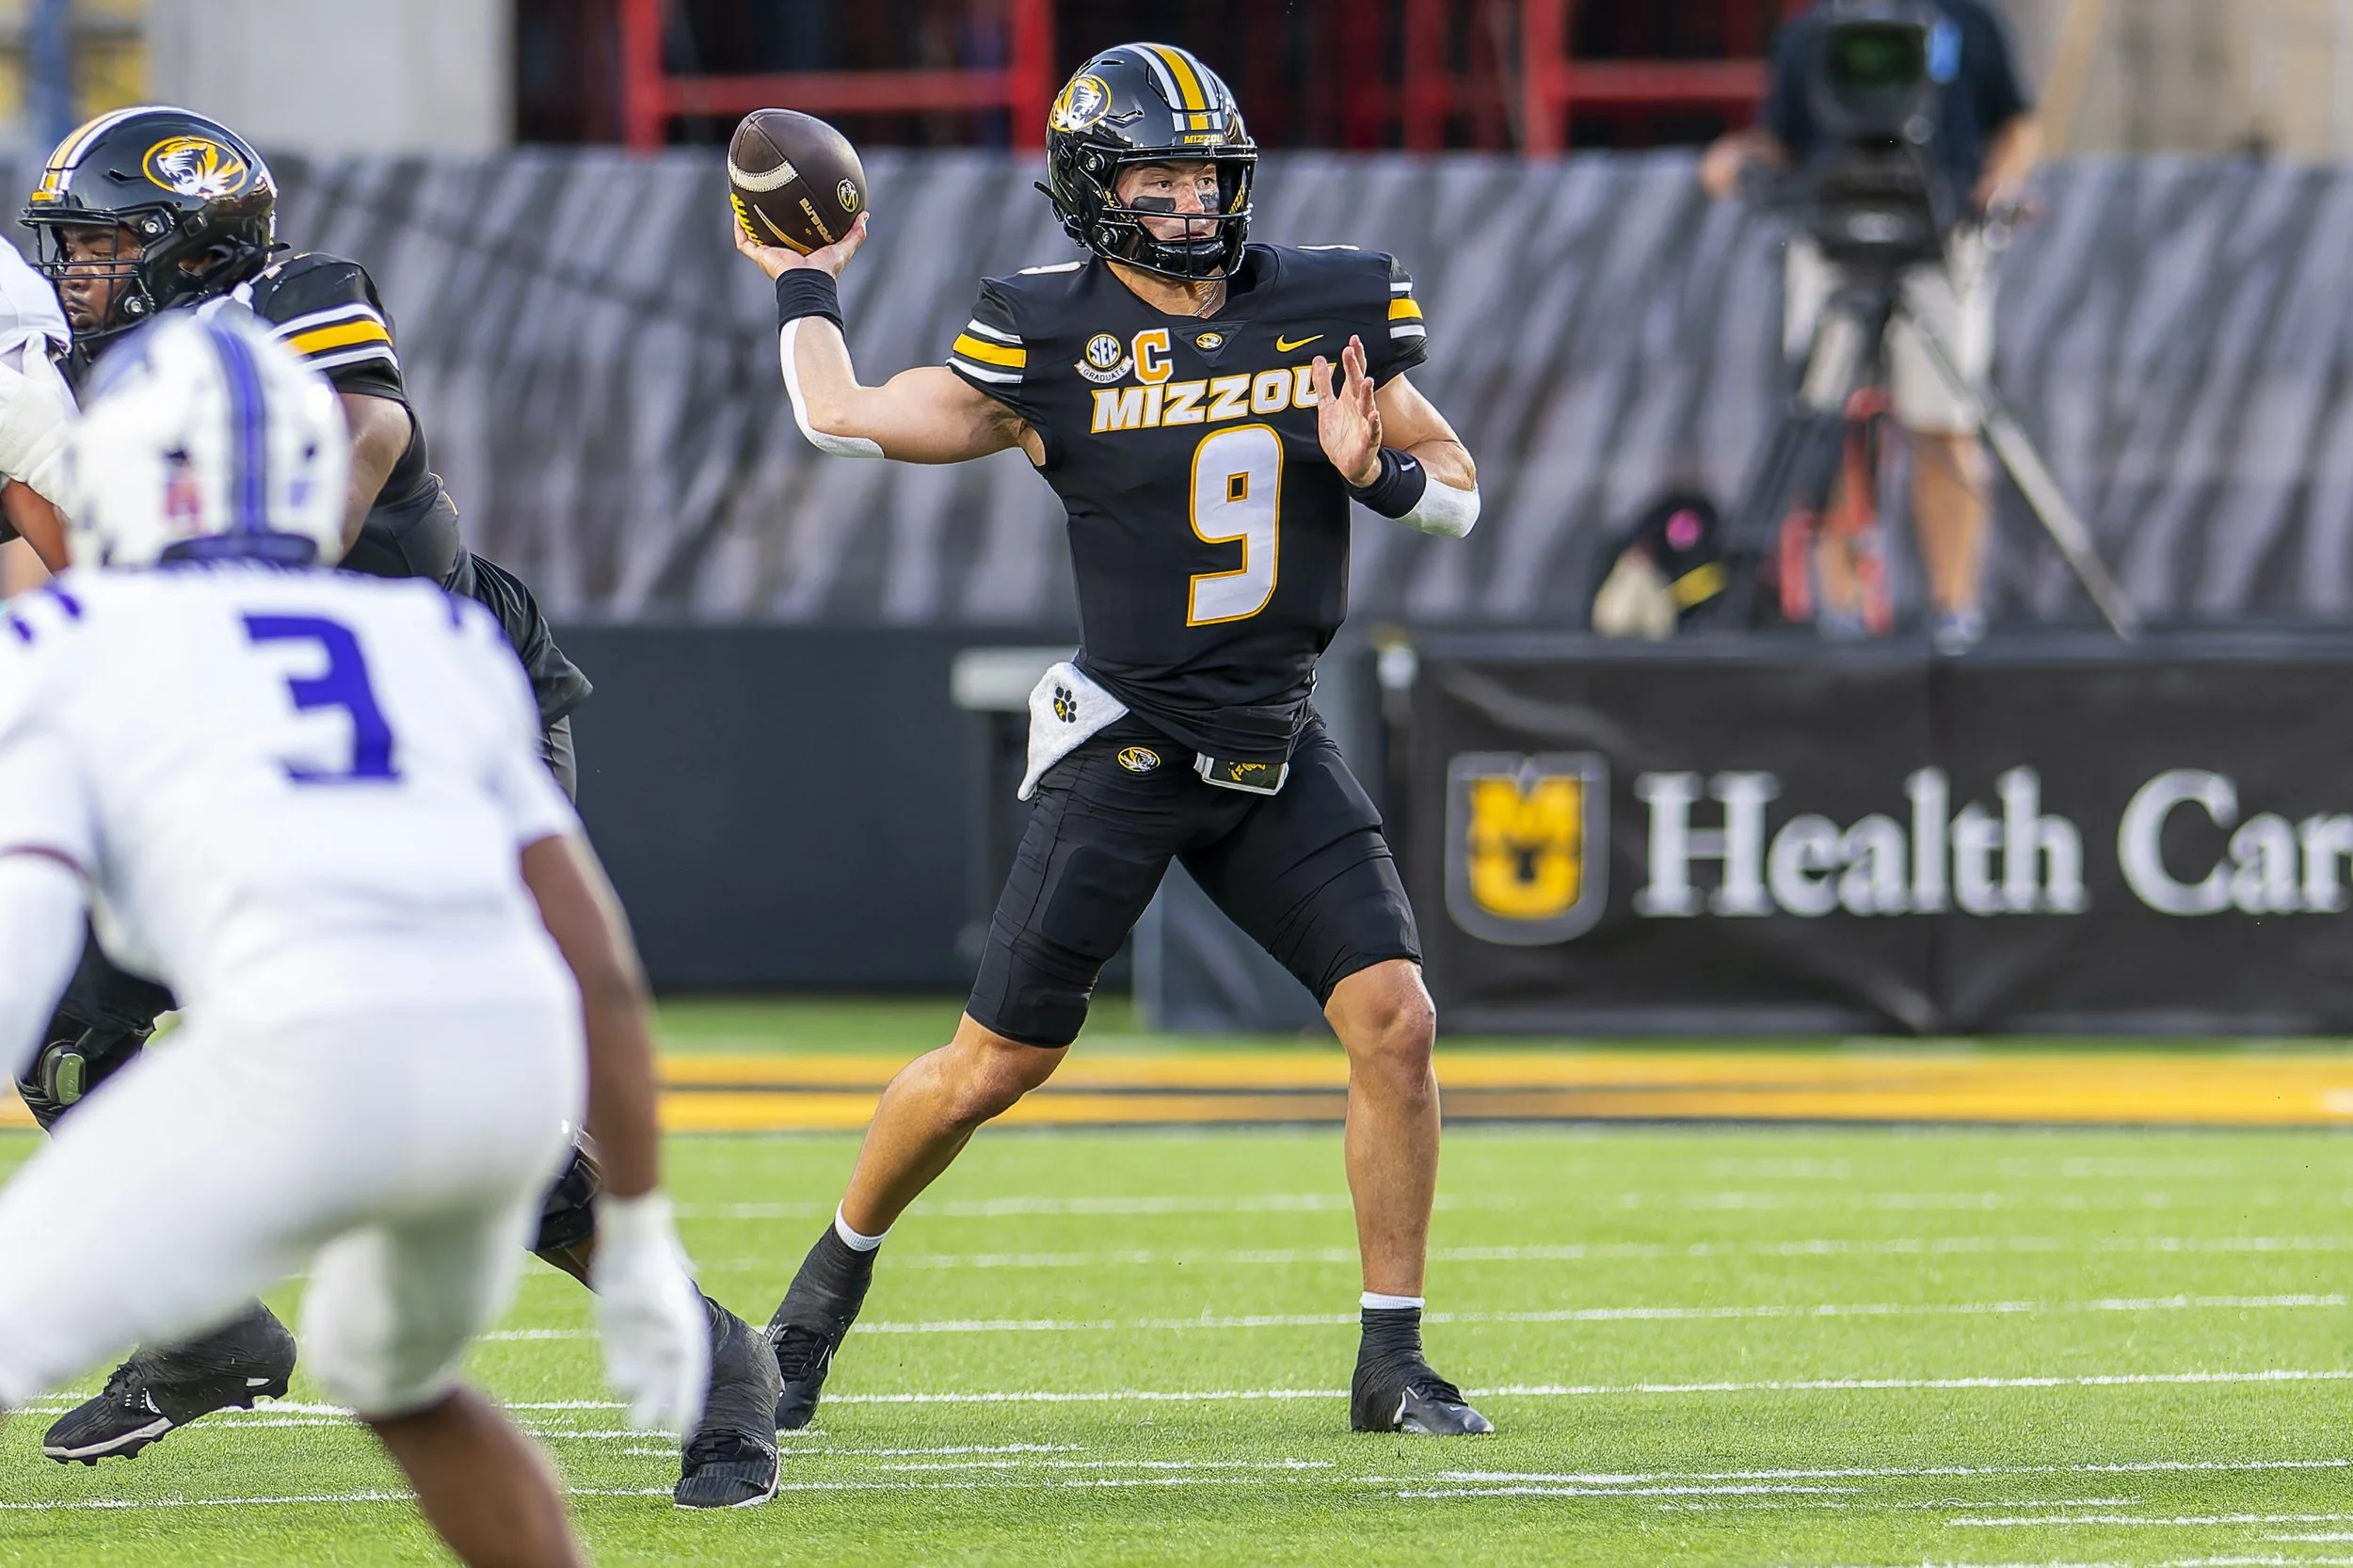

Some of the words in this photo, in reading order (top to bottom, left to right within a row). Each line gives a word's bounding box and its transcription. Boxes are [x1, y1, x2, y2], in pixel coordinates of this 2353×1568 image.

[1184, 135, 1224, 145] MIZZOU
[1082, 365, 1128, 383] GRADUATE
[1089, 337, 1118, 365] SEC
[1131, 328, 1175, 385] C
[1186, 423, 1284, 627] 9
[243, 614, 401, 783] 3
[1634, 766, 2091, 917] Health
[2116, 767, 2353, 917] Car
